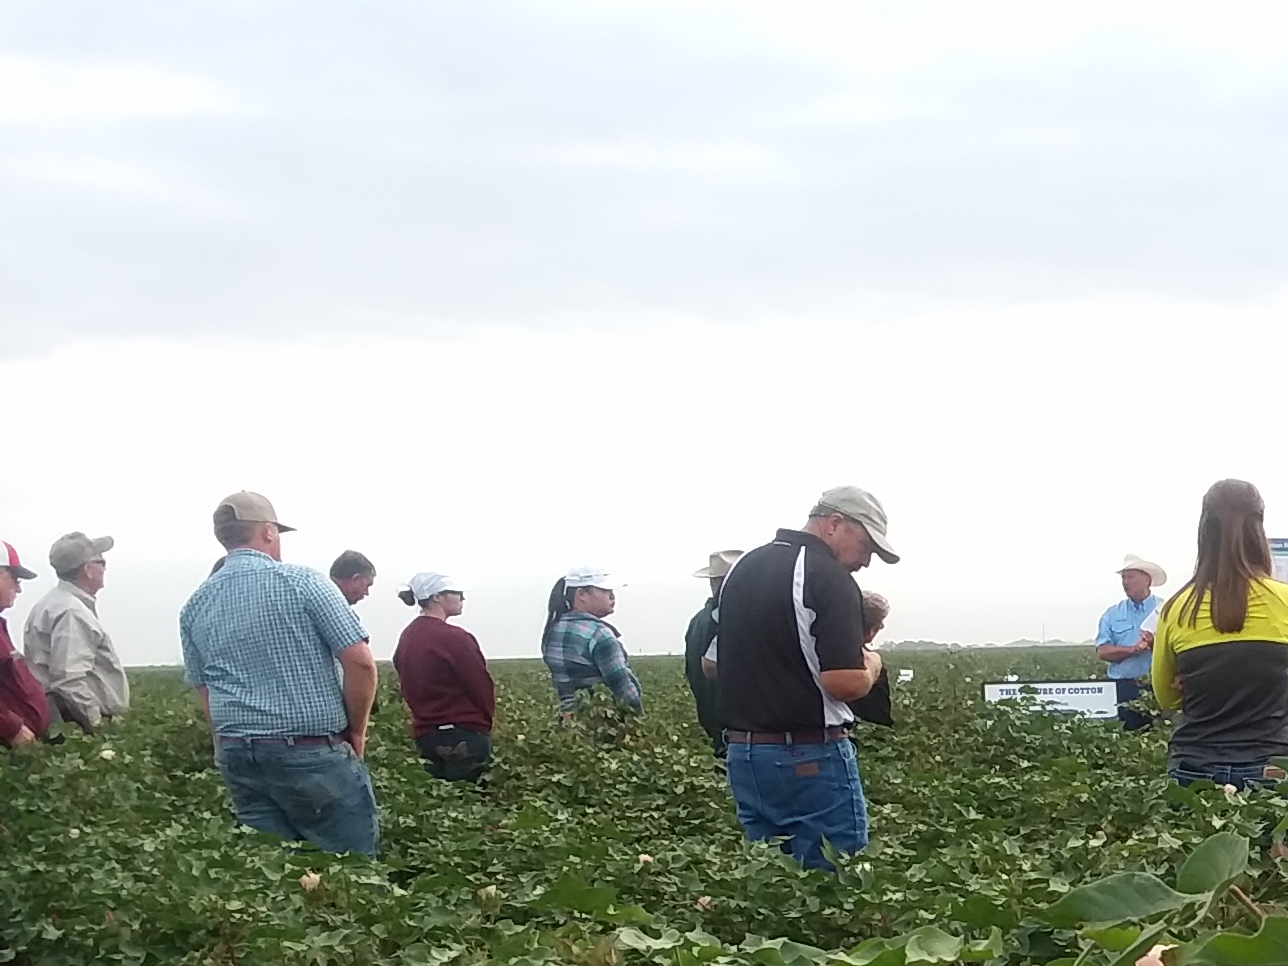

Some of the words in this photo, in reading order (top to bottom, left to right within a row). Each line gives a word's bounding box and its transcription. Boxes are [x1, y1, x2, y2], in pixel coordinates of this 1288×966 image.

[999, 688, 1017, 696] THE
[1056, 687, 1066, 695] OF
[1068, 686, 1103, 695] COTTON
